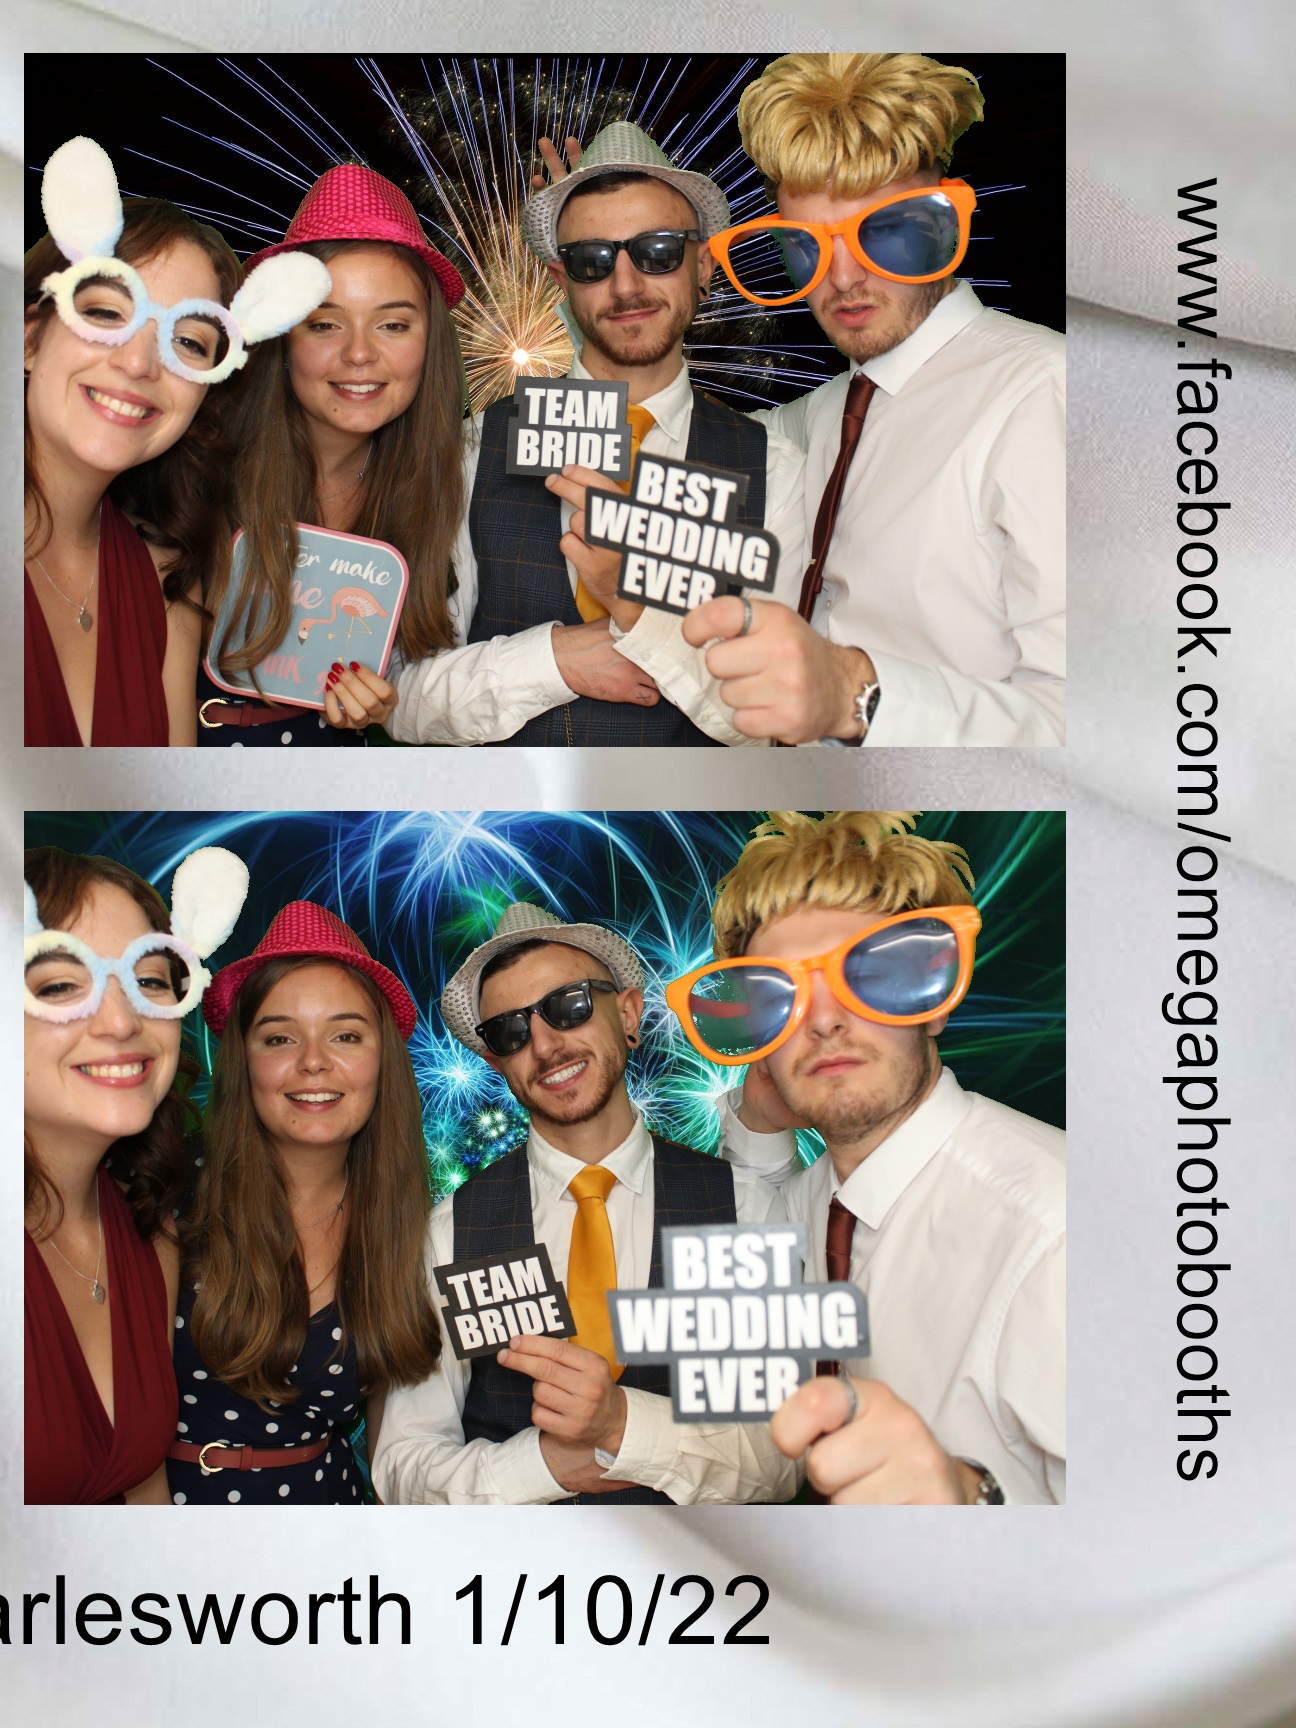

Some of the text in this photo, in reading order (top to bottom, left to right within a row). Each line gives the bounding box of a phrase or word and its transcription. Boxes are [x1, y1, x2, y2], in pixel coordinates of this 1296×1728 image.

[524, 387, 619, 430] TEAM
[516, 428, 622, 472] BRIDE
[635, 459, 738, 523] BEST
[589, 495, 771, 584] WEDDING
[329, 557, 393, 587] make
[622, 551, 717, 611] EVER
[446, 1256, 548, 1311] TEAM
[671, 1232, 798, 1291] BEST
[454, 1294, 565, 1351] BRIDE
[616, 1291, 859, 1353] WEDDING
[677, 1356, 801, 1413] EVER
